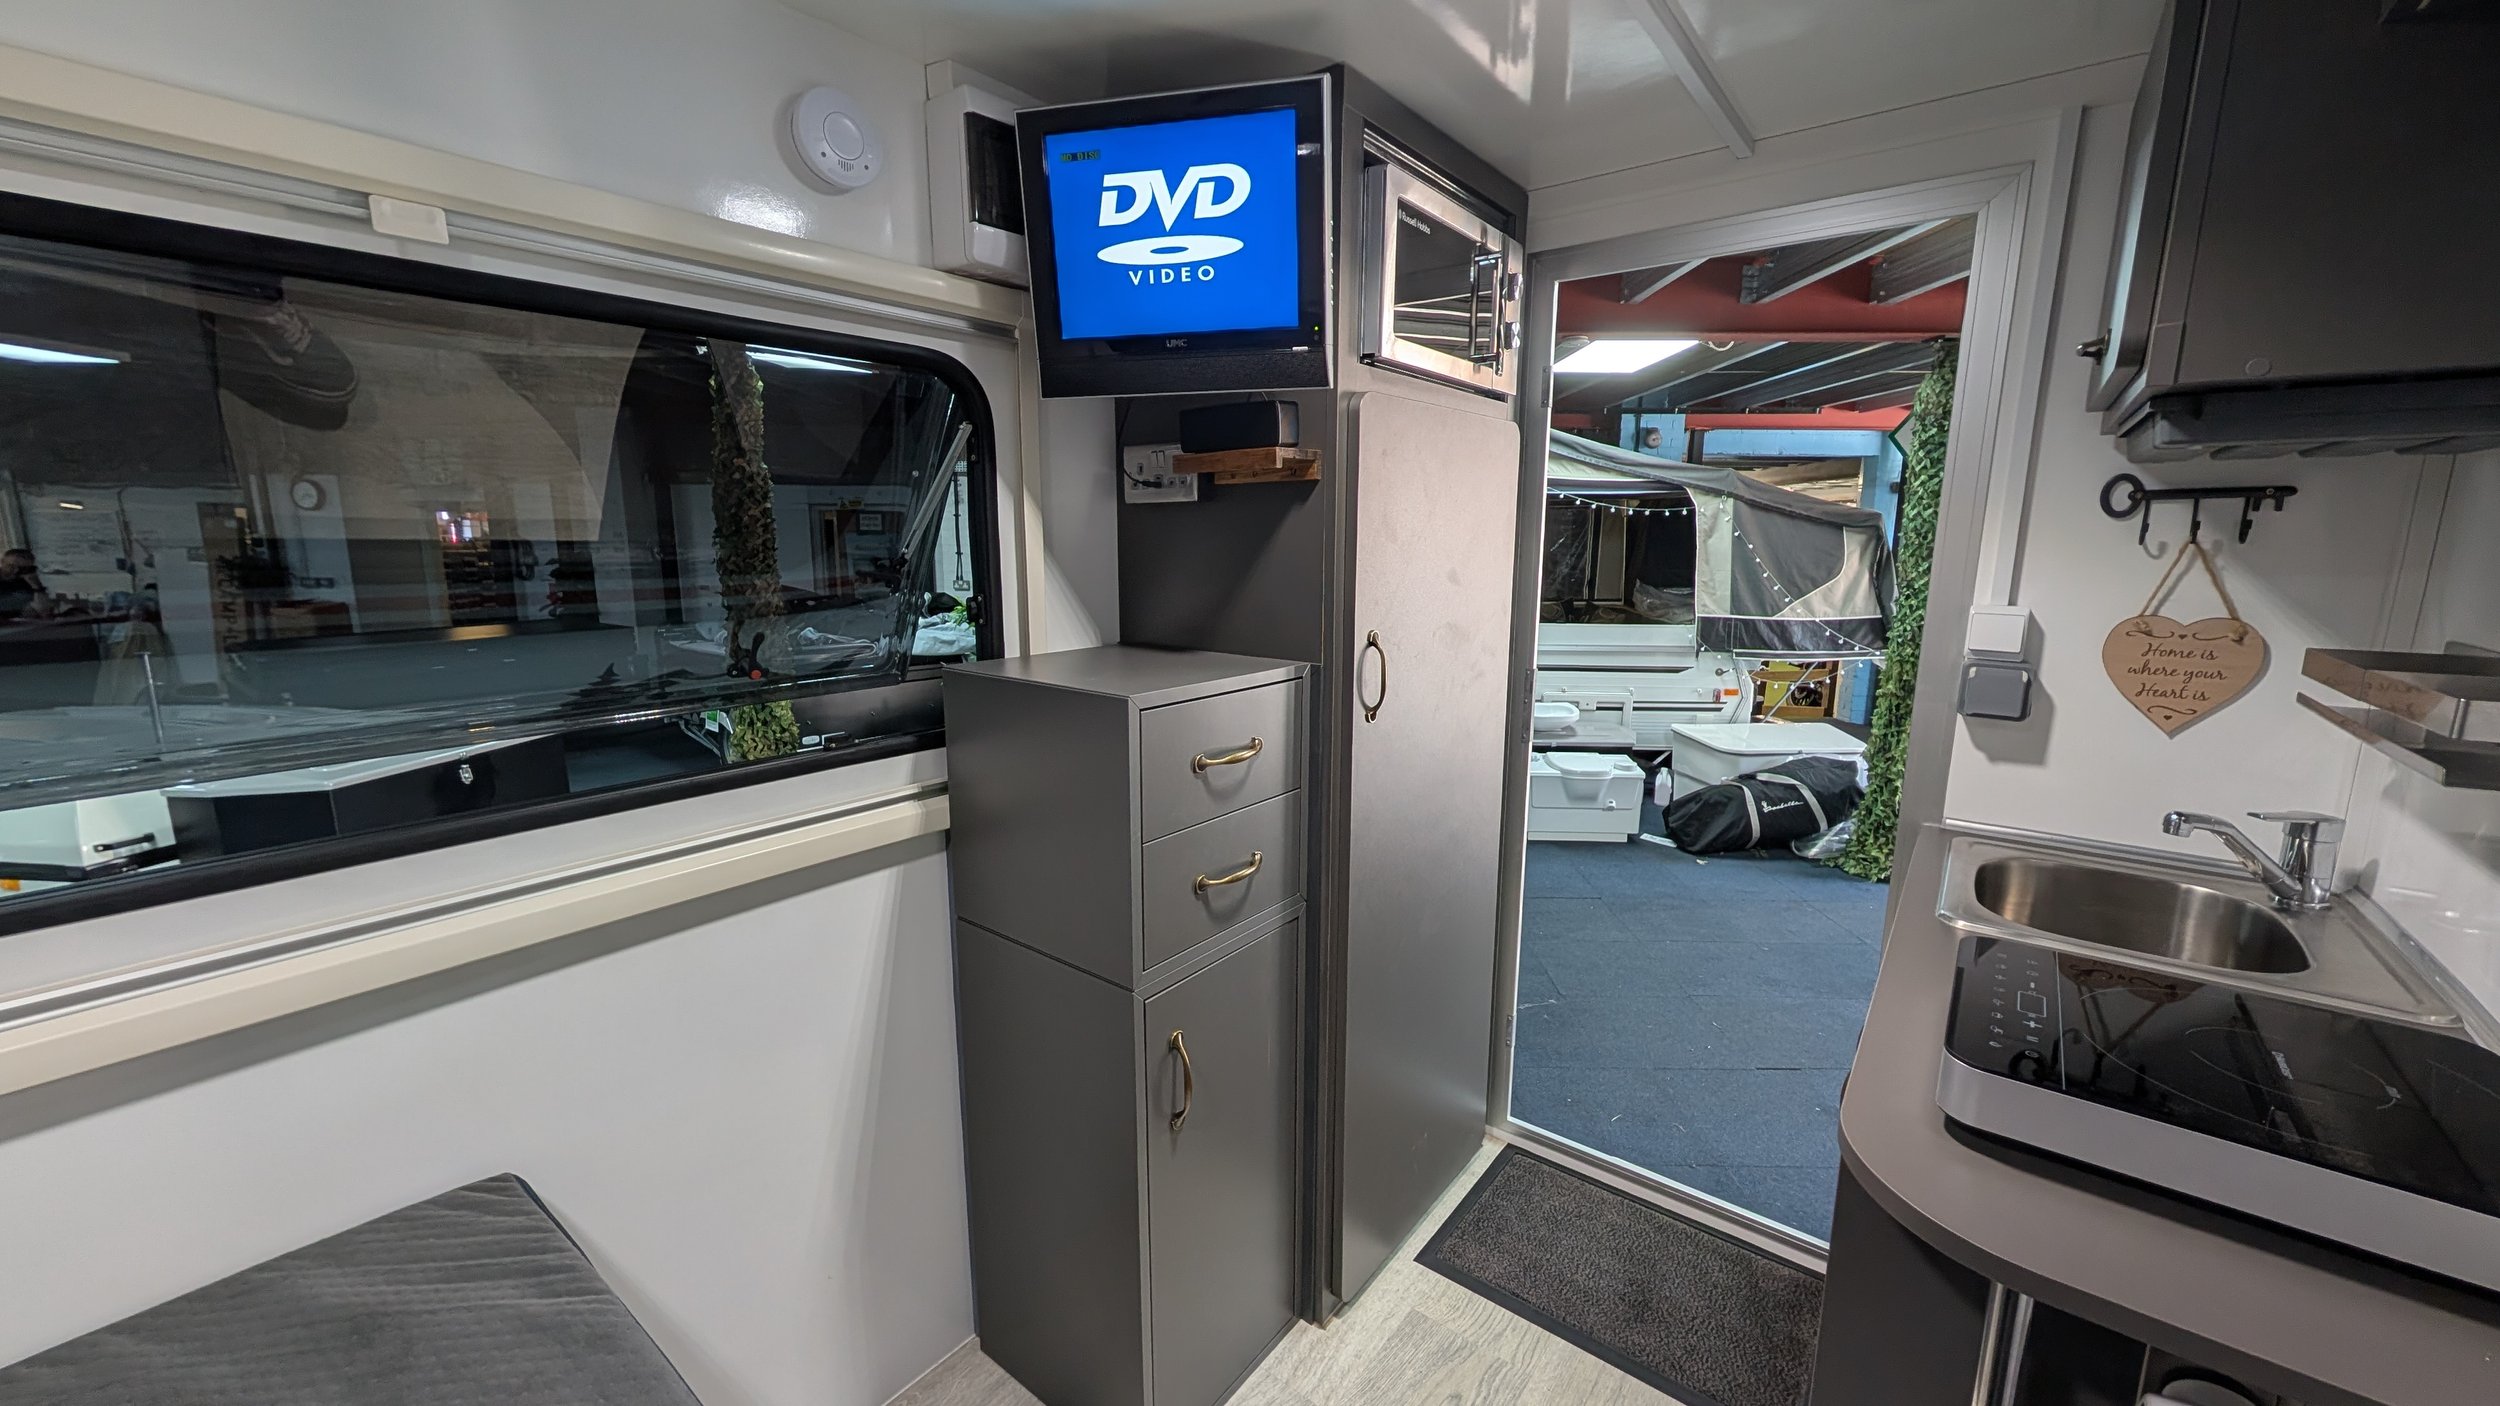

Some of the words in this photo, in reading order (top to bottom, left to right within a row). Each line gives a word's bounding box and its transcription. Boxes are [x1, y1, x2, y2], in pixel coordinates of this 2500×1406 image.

[1098, 163, 1252, 232] DVD
[1401, 211, 1417, 228] Russell
[1417, 219, 1431, 235] Hobbs
[1128, 265, 1215, 286] VIDEO
[2141, 642, 2196, 659] Home
[2200, 648, 2218, 661] is
[2127, 659, 2181, 677] where
[2182, 669, 2228, 684] your
[2135, 682, 2190, 700] Heart
[2192, 689, 2211, 702] is
